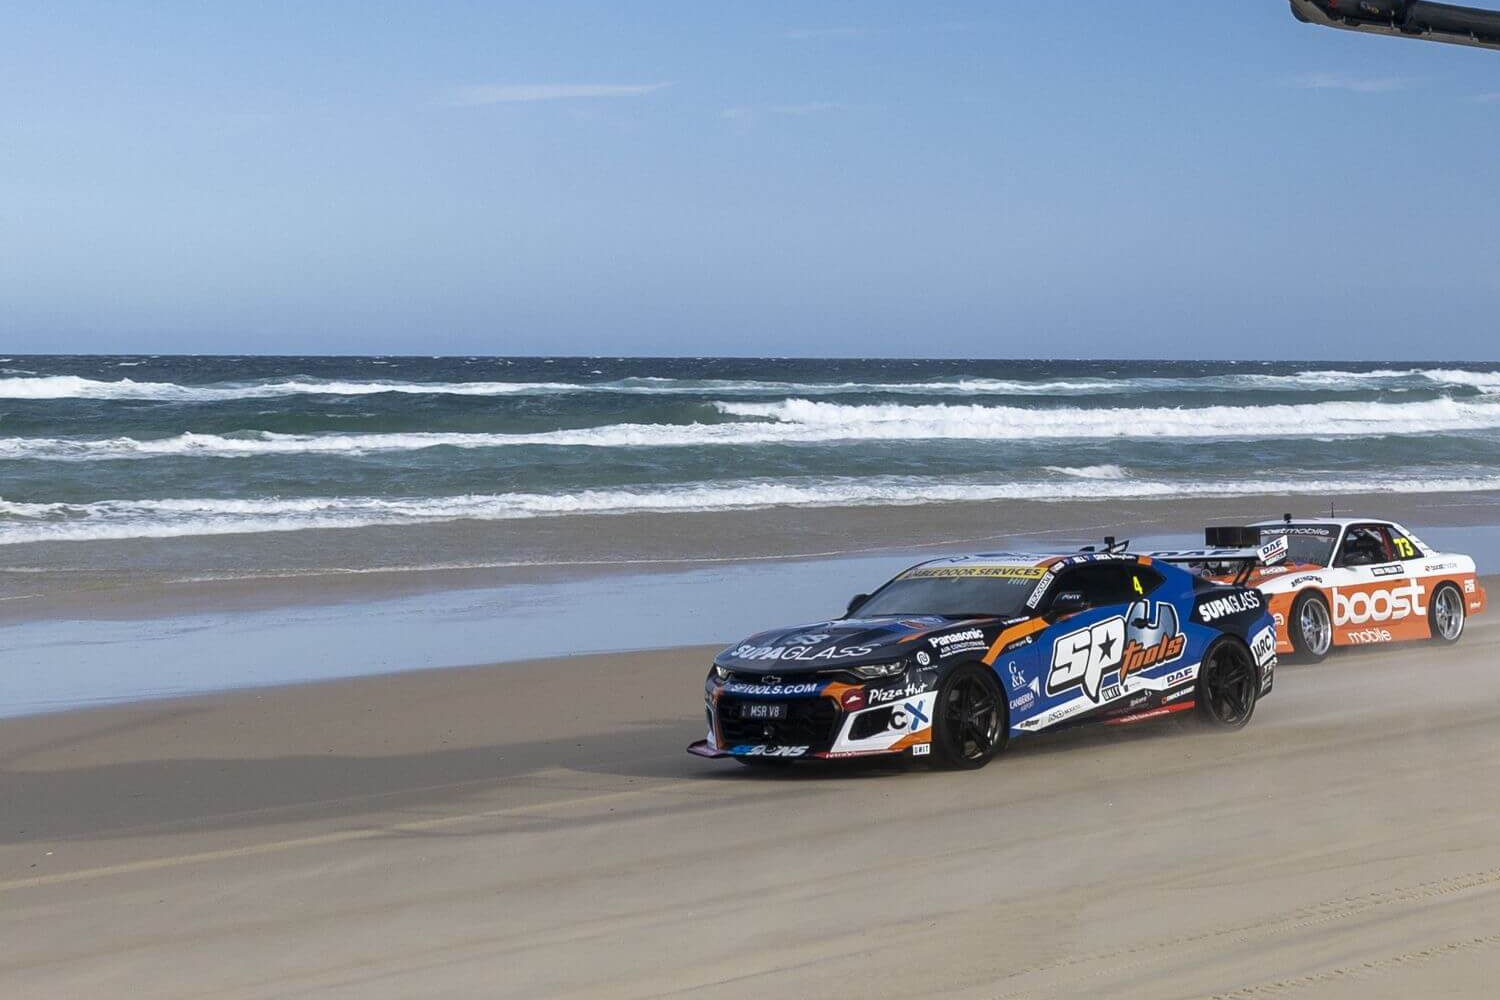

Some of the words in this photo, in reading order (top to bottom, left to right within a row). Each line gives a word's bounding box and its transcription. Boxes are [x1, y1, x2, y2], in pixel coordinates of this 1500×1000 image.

[1262, 540, 1282, 555] DAF
[1393, 538, 1414, 557] 73
[976, 568, 1041, 576] SERVICES
[1132, 576, 1143, 594] 4
[1199, 591, 1260, 622] SUPAGLASS
[1332, 578, 1427, 626] boost
[928, 628, 984, 648] Panasonic
[1348, 629, 1392, 643] mobile
[731, 644, 881, 661] SUPAGLASS
[1047, 616, 1126, 702] SP
[1120, 632, 1184, 684] tools
[1166, 668, 1193, 683] DAF
[868, 688, 904, 704] Pizza
[905, 683, 928, 697] Hut
[750, 705, 767, 717] MSR
[769, 705, 780, 717] V8
